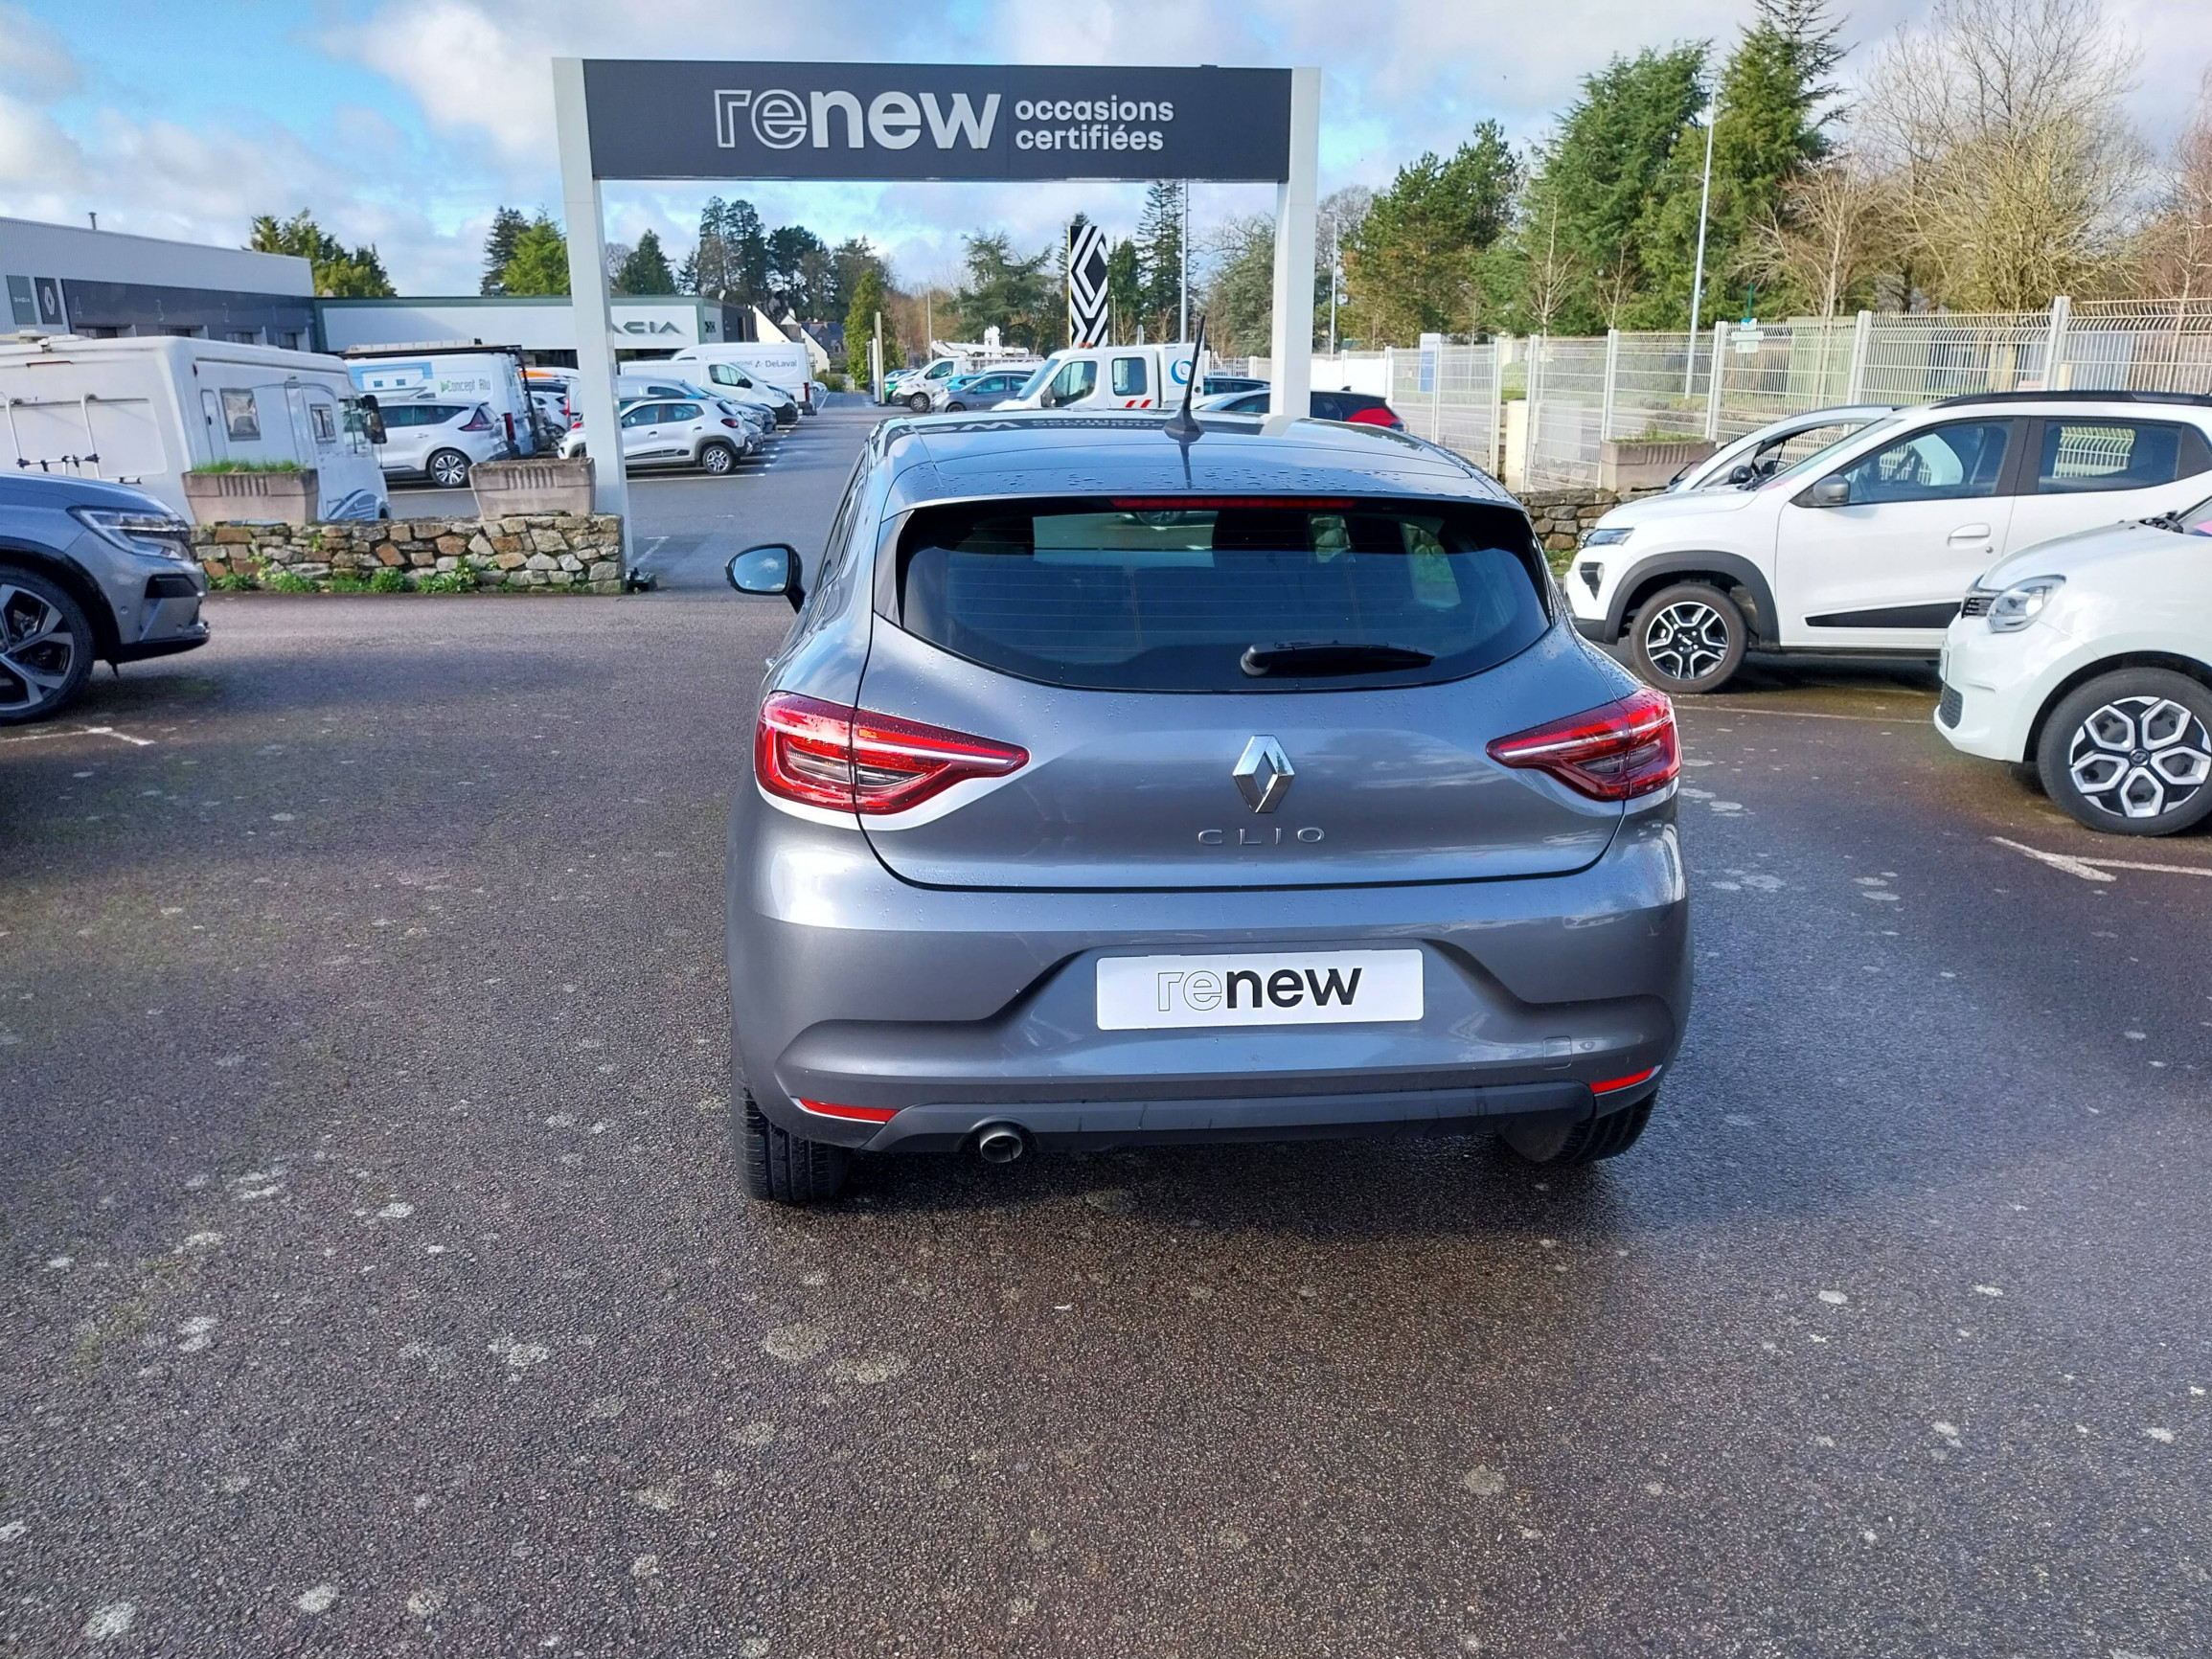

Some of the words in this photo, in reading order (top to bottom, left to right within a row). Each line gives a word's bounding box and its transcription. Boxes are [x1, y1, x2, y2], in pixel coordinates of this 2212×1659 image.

[714, 89, 1001, 149] renew
[1015, 94, 1174, 122] occasions
[1015, 124, 1164, 150] certifiées
[764, 359, 797, 368] DeLaval
[446, 379, 476, 394] Concept
[1197, 827, 1325, 846] CLIO
[1157, 967, 1363, 1012] renew
